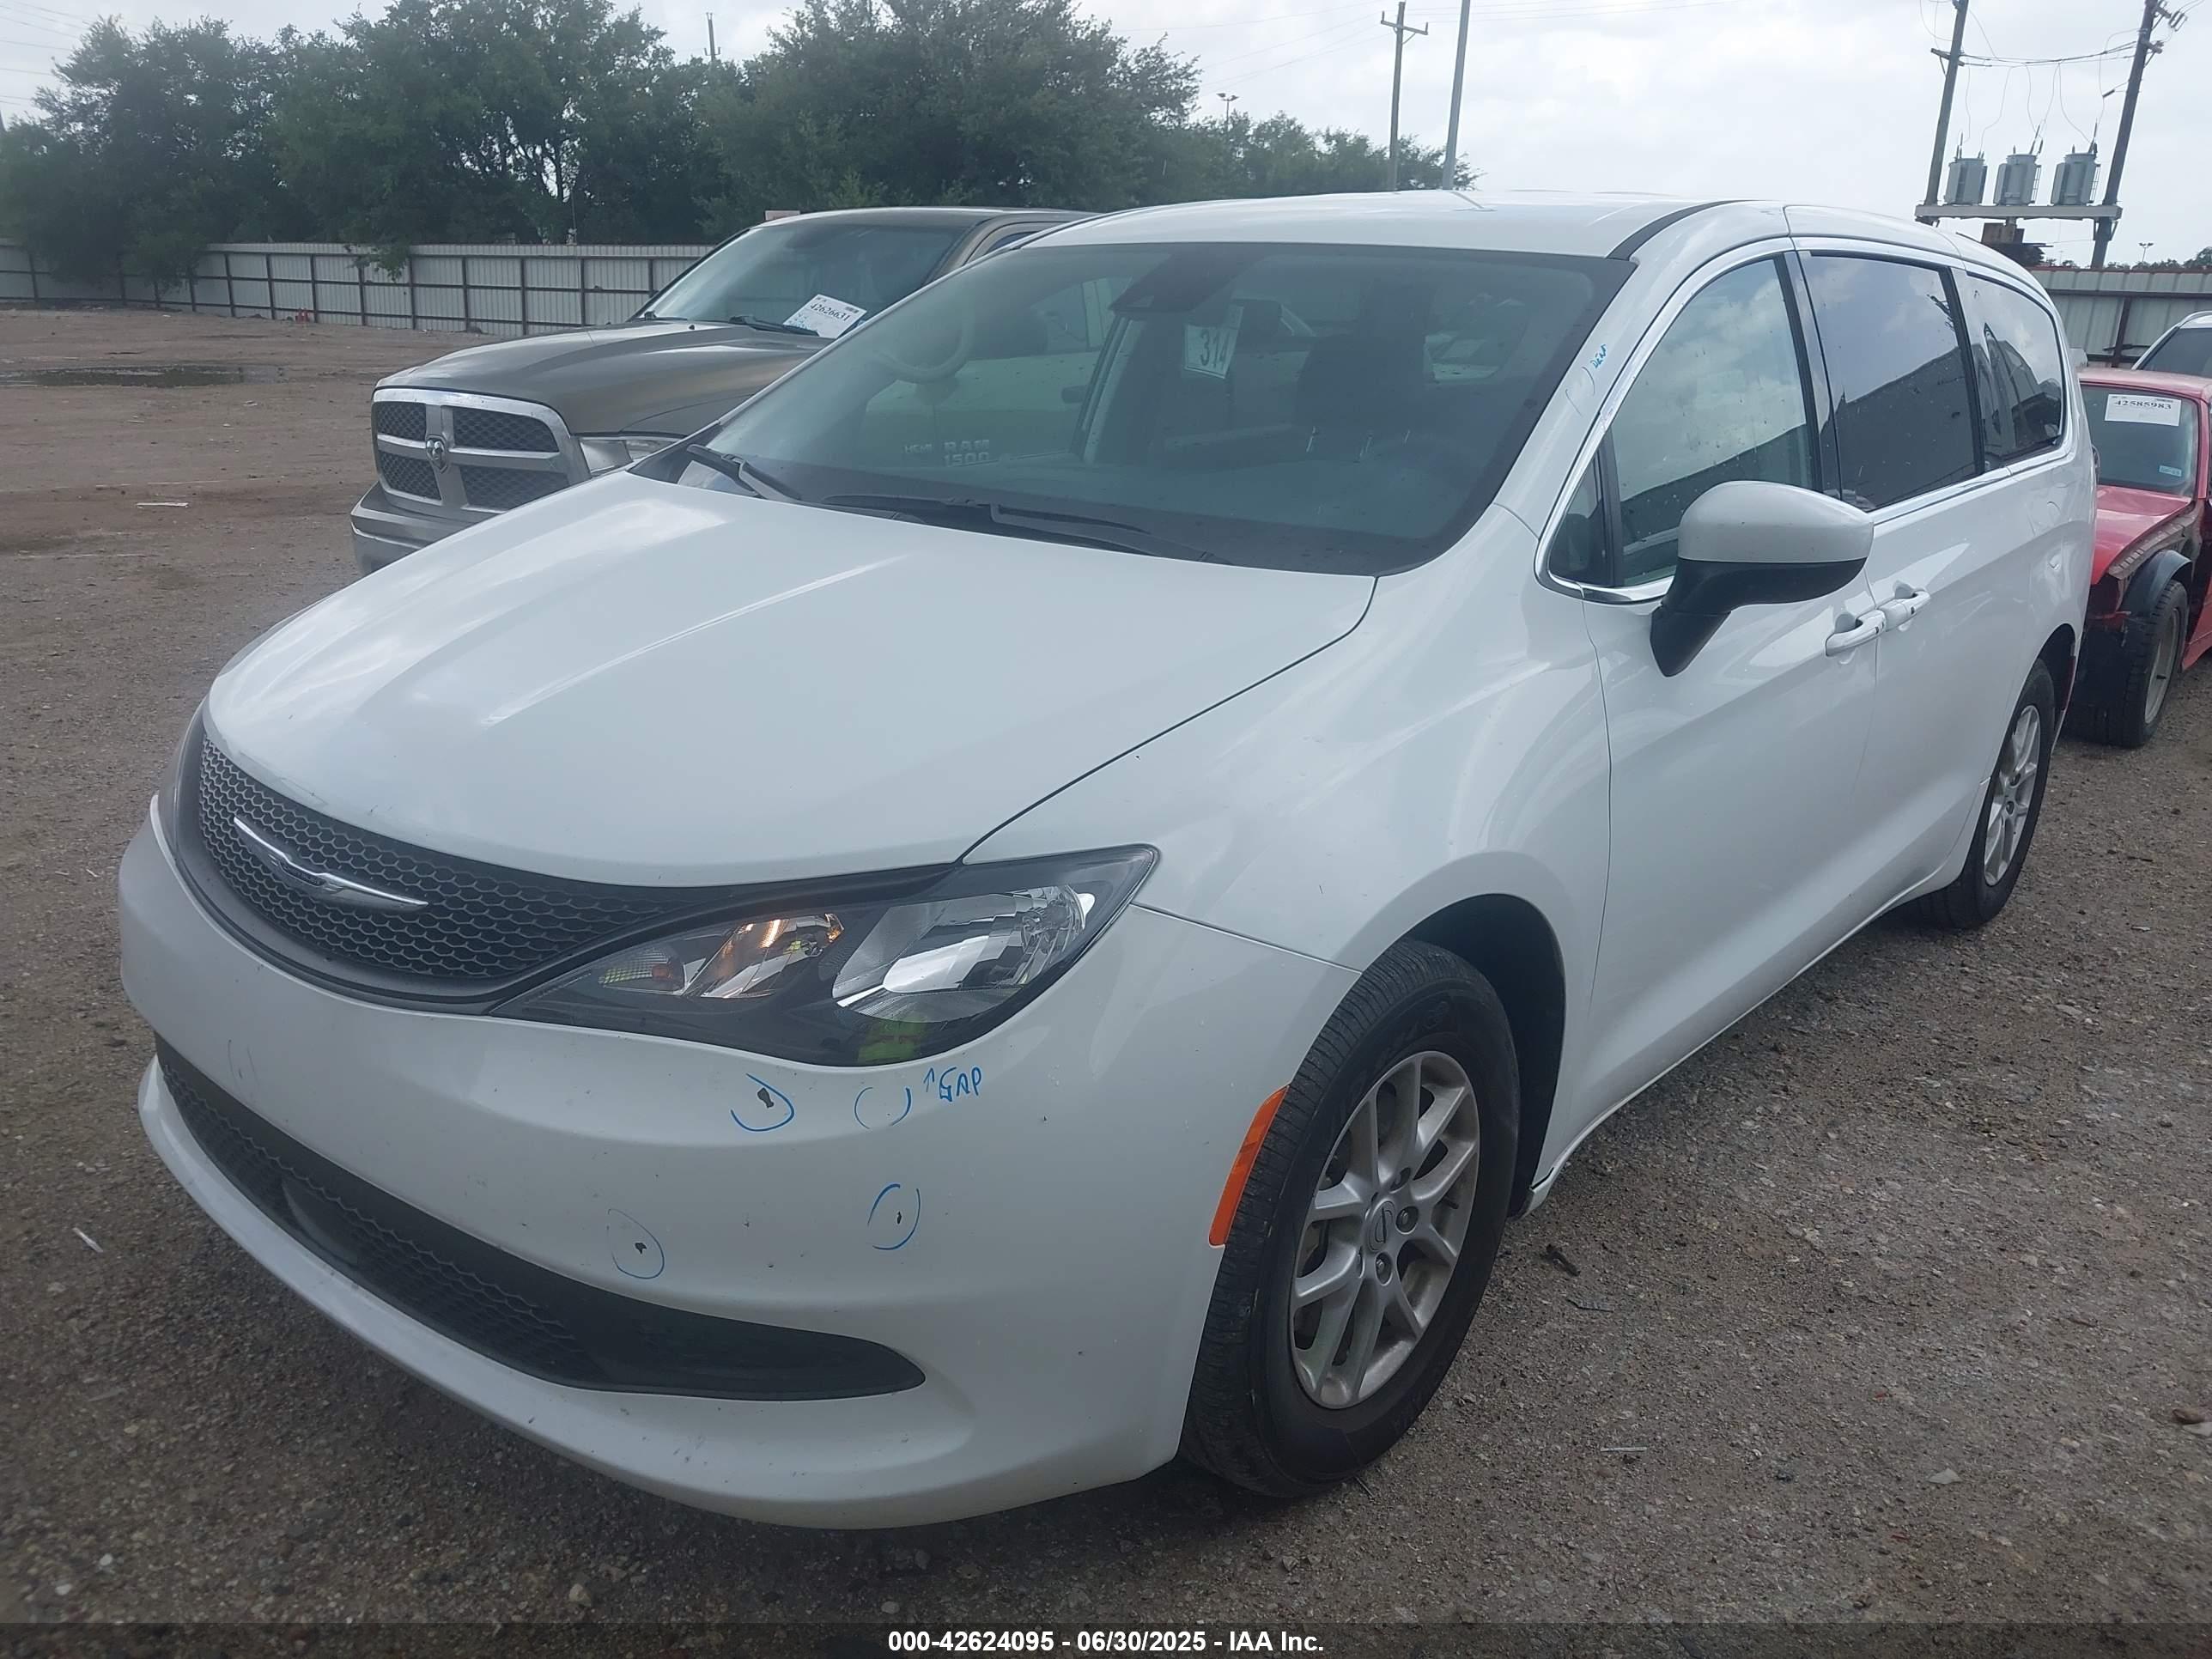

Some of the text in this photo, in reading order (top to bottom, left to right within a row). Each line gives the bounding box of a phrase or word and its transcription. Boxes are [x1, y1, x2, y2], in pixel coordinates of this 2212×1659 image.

[810, 302, 851, 322] 42626631
[2113, 399, 2172, 410] 42585983
[944, 452, 990, 467] 1500
